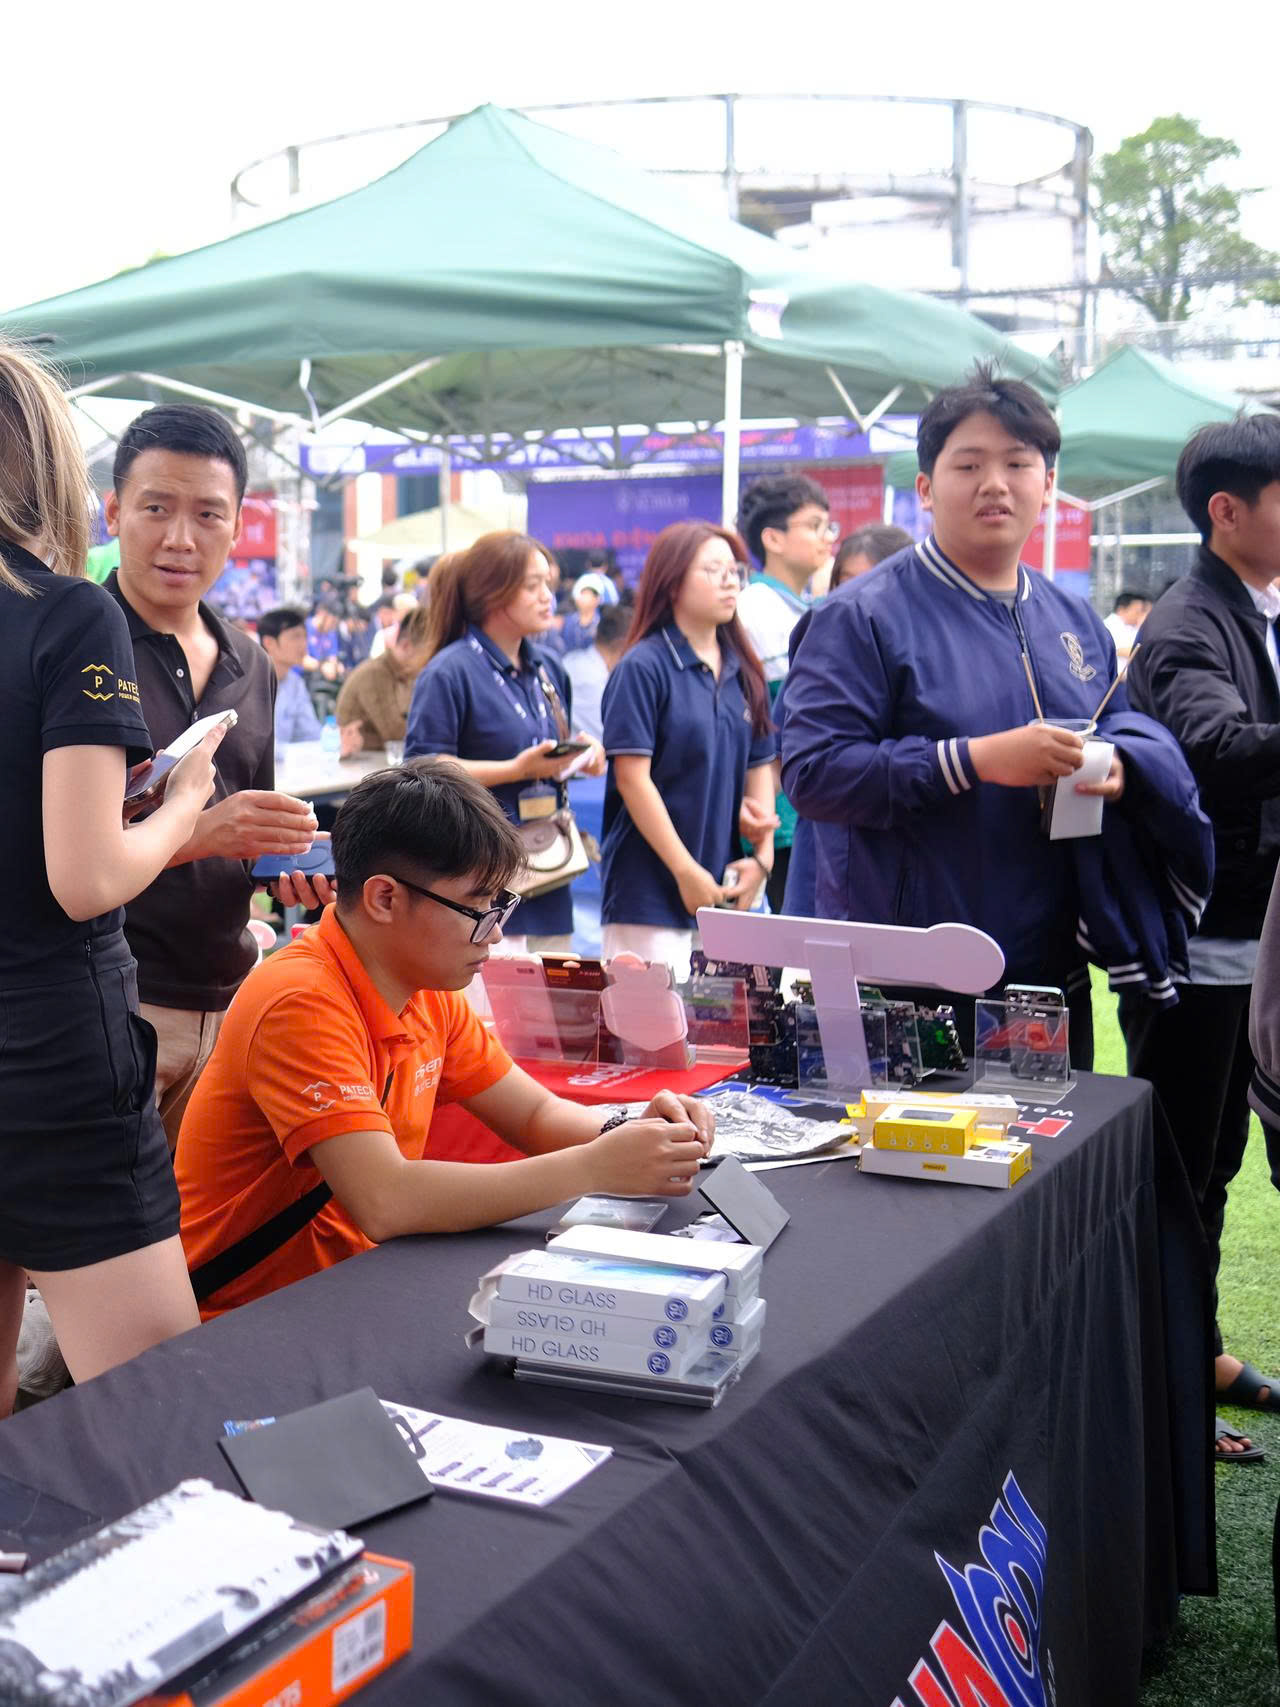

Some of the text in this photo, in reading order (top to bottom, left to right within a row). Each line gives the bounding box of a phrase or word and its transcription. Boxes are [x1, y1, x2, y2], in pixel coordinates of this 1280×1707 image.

[528, 1283, 616, 1309] HD GLASS
[517, 1310, 606, 1337] HD GLASS
[511, 1335, 600, 1362] HD GLASS
